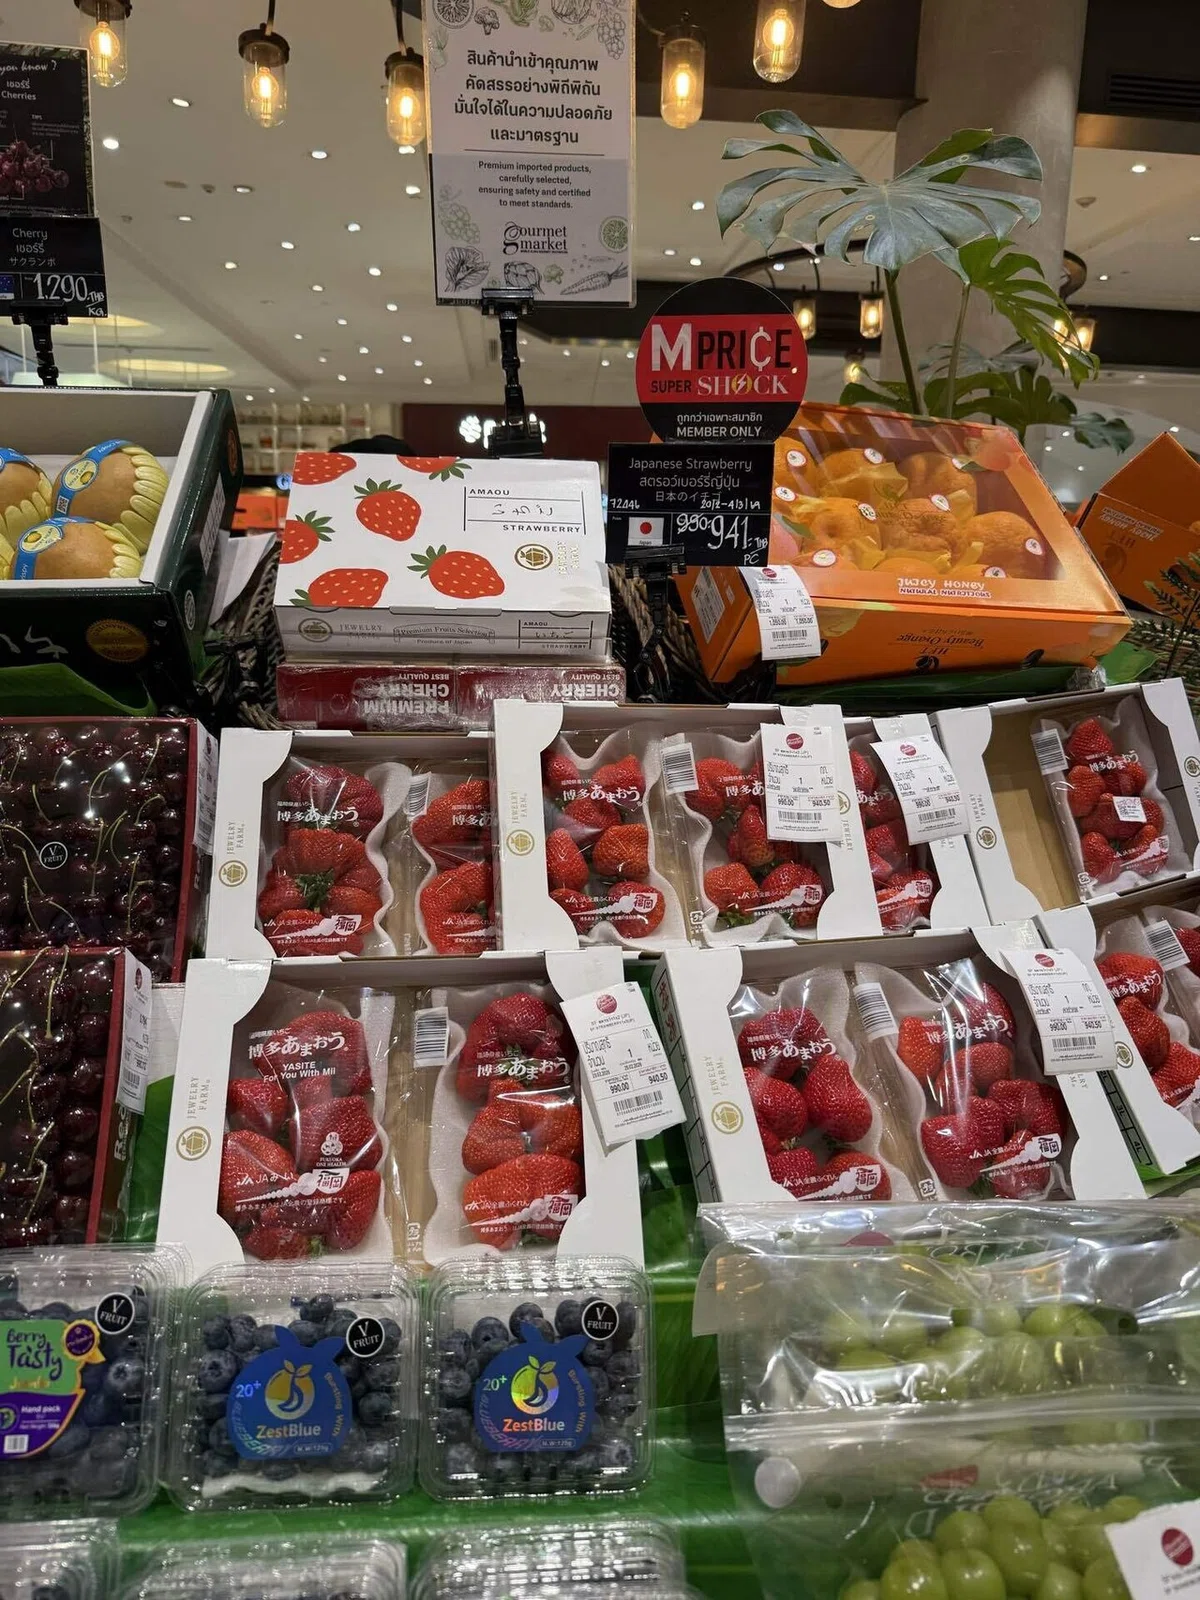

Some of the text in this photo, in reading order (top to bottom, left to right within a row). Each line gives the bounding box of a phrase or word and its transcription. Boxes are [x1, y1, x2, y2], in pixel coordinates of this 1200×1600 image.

[466, 49, 599, 74] สินค้านำเข้าคุณภาพ
[465, 73, 601, 96] คัดสรรอย่างพิถีพิถัน
[1, 90, 37, 100] Cherries
[454, 94, 613, 120] มั่นใจได้ในความปลอดภัย
[490, 128, 579, 146] และมาตรฐาน
[478, 160, 592, 174] Premium imported products,
[498, 175, 572, 185] carefully selected,
[478, 186, 591, 197] ensuring safety and certified
[531, 200, 573, 209] standards.
[12, 228, 48, 240] Cherry
[16, 240, 45, 253] เชอร์รี่
[520, 237, 568, 251] market
[651, 323, 692, 371] M
[651, 373, 788, 396] SUPER SHOCK
[677, 411, 763, 427] ถูกกว่าเฉพาะสมาชิก
[677, 426, 762, 437] MEMBER ONLY
[628, 458, 752, 472] Japanese Strawberry
[469, 488, 510, 496] AMAOU
[503, 524, 580, 533] STRAWBERRY
[743, 553, 760, 566] PC
[944, 579, 985, 591] HONEY
[401, 626, 488, 638] Premium Fruits Selection
[398, 672, 450, 681] BEST QUALITY
[571, 673, 620, 682] BEST QUALITY
[378, 683, 450, 699] CHERRY
[550, 683, 620, 699] CHERRY
[364, 699, 450, 715] PREMIUM
[563, 784, 640, 803] 博多あまおう
[277, 806, 359, 825] 博多あまおう
[227, 820, 236, 855] JEWELRY
[804, 886, 820, 900] 福岡
[634, 894, 653, 909] 福岡
[335, 915, 357, 932] 福岡
[925, 1015, 1009, 1043] 博多あまおう
[248, 1031, 345, 1059] 博多あまおう
[751, 1038, 837, 1061] 博多あまおう
[627, 1048, 633, 1058] 1
[282, 1061, 316, 1071] YASITE
[477, 1056, 571, 1080] 博多あまおう
[280, 1071, 297, 1080] You
[299, 1069, 320, 1078] With
[647, 1072, 668, 1085] 940.50
[703, 1055, 721, 1096] JEWELRY
[198, 1079, 208, 1111] FARM
[610, 1082, 629, 1094] 990.00
[187, 1076, 198, 1118] JEWELRY
[1039, 1138, 1059, 1153] 福岡
[1133, 1141, 1143, 1153] 4L
[317, 1170, 343, 1189] 福岡
[856, 1168, 877, 1186] 福岡
[548, 1196, 572, 1216] 福岡
[111, 1299, 125, 1314] V
[595, 1306, 607, 1321] V
[100, 1311, 128, 1326] FRUIT
[587, 1320, 614, 1330] FRUIT
[358, 1321, 369, 1336] V
[6, 1328, 46, 1348] Berry
[353, 1335, 381, 1349] FRUIT
[7, 1342, 63, 1381] Tasty
[567, 1369, 588, 1433] Bursting With
[21, 1405, 61, 1414] Hand pack
[256, 1423, 322, 1439] ZestBlue
[332, 1413, 346, 1437] With
[502, 1418, 565, 1432] ZestBlue
